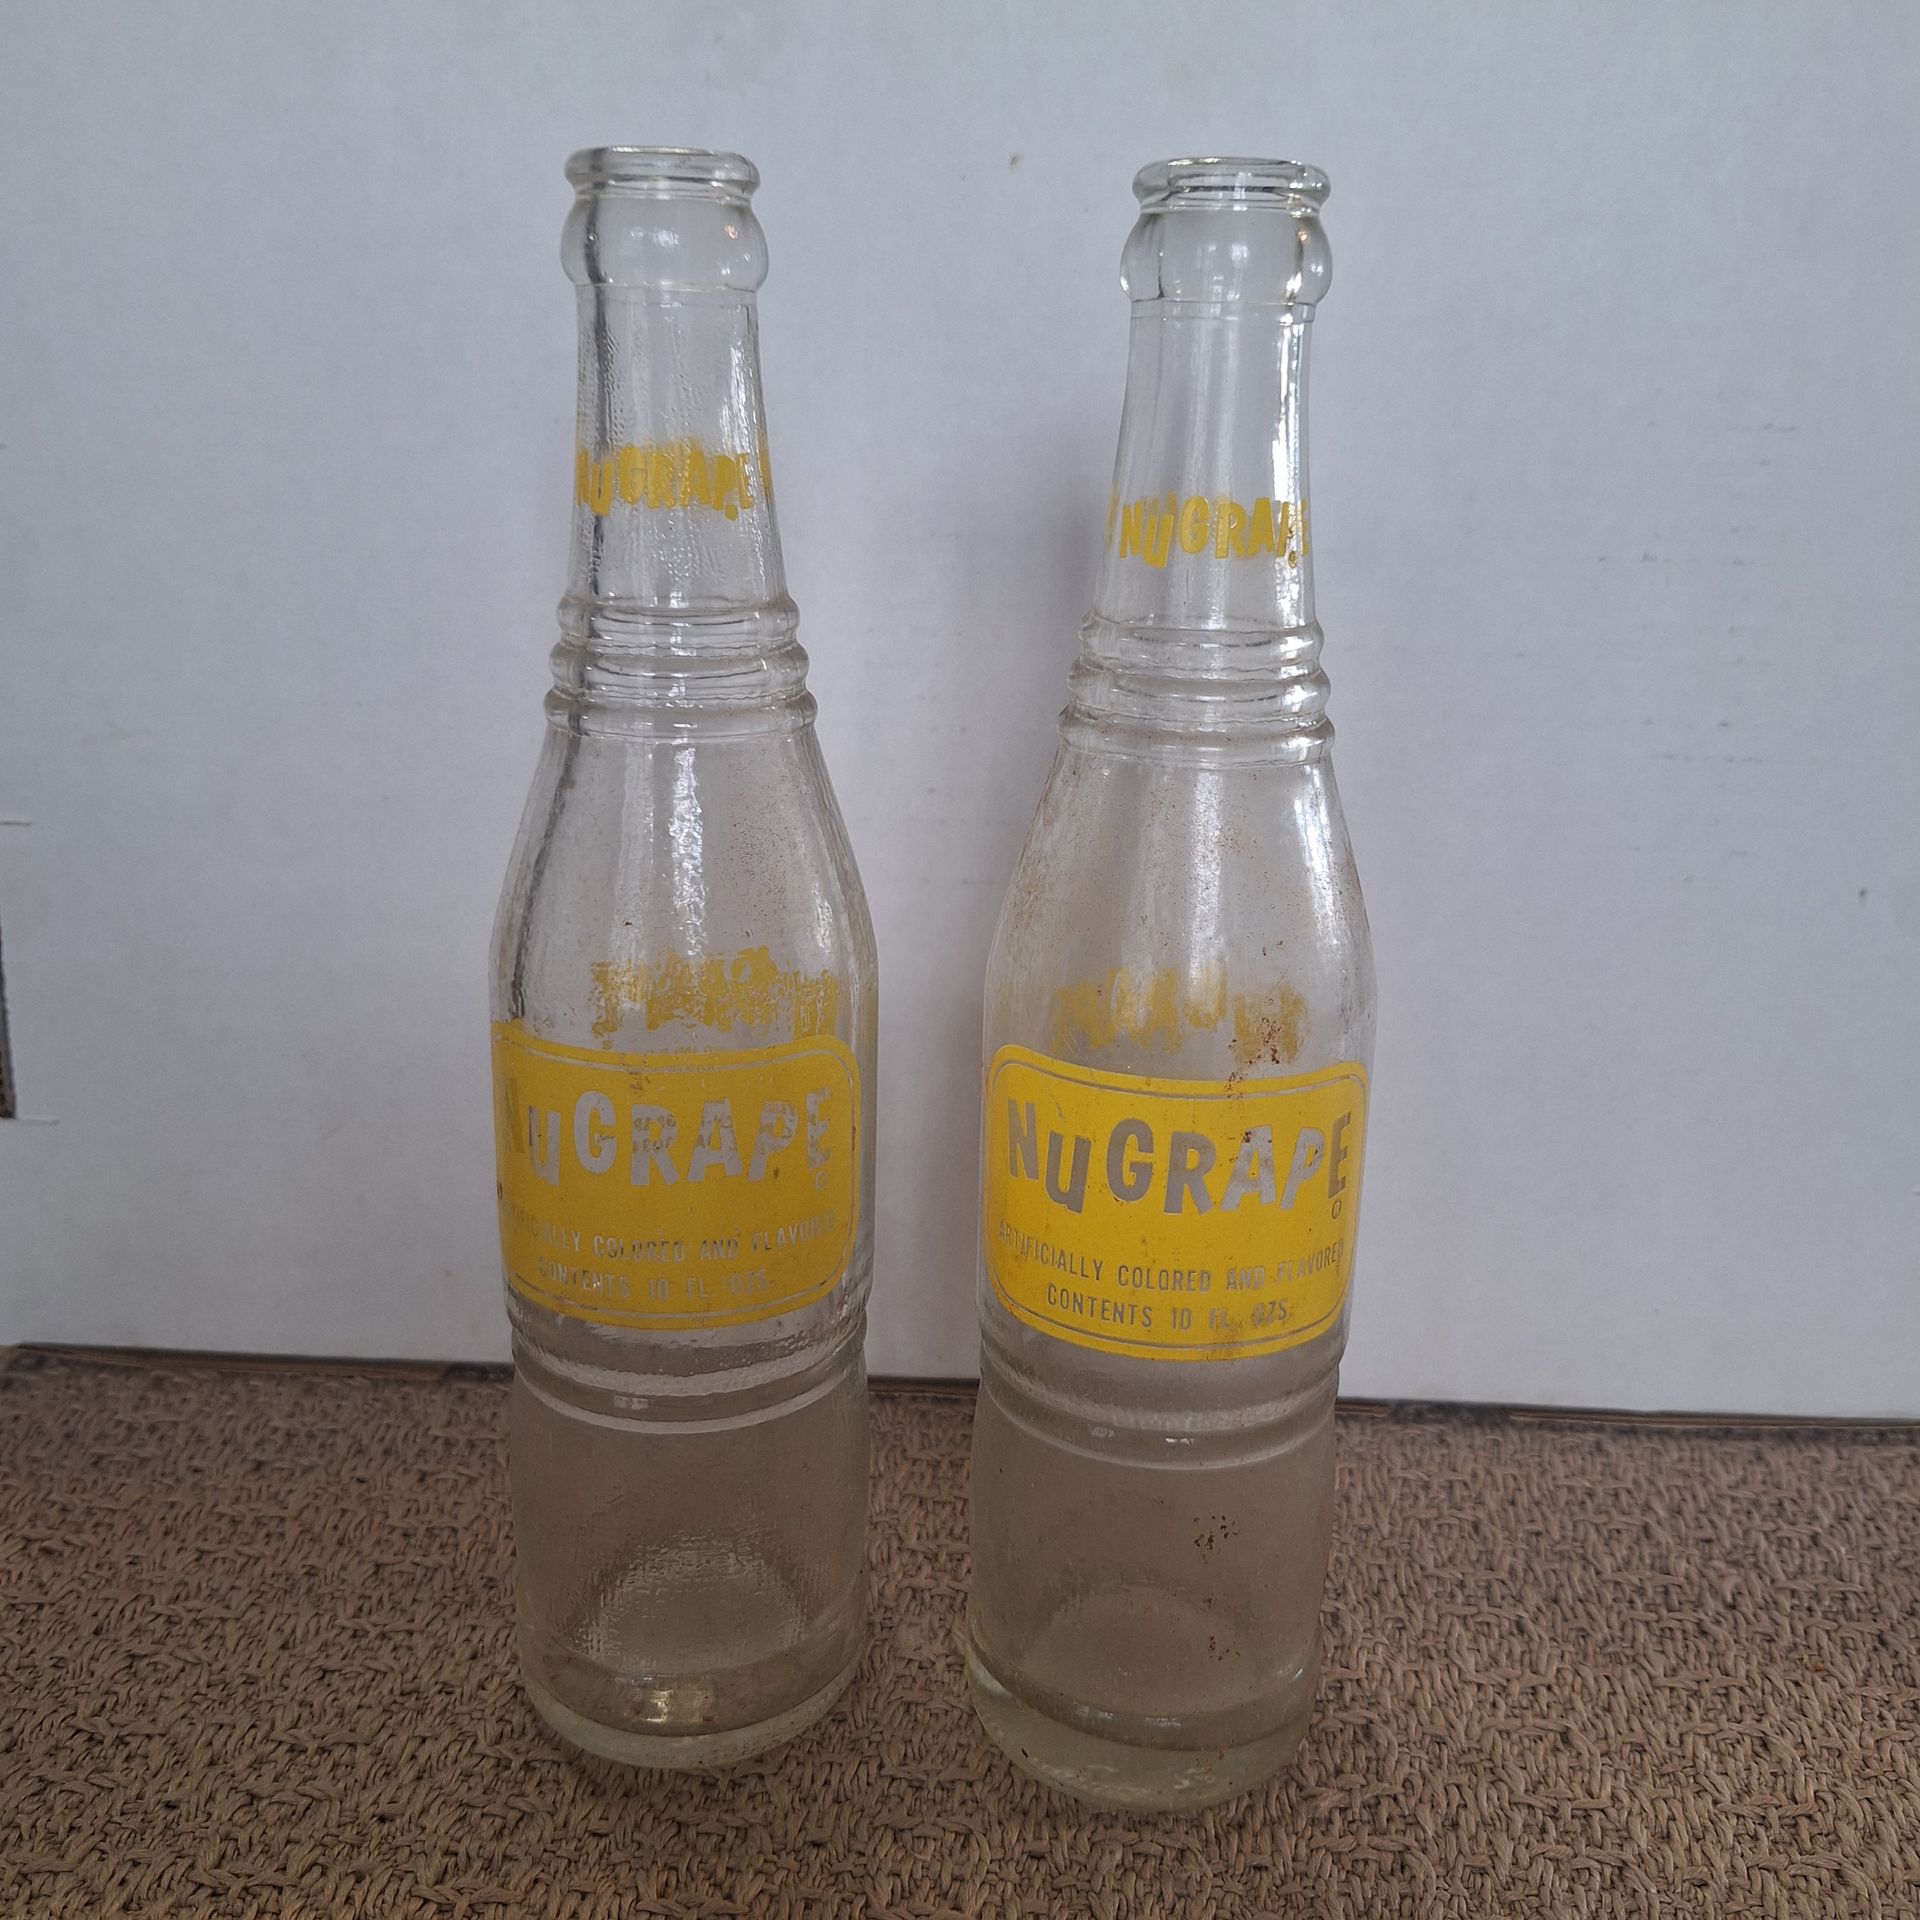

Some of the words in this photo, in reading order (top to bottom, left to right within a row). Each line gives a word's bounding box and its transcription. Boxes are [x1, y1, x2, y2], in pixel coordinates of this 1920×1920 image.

[700, 1237, 740, 1263] AND
[999, 1218, 1104, 1281] ARTIFICIALLY
[1117, 1264, 1211, 1292] COLORED
[1226, 1265, 1266, 1291] AND
[537, 1256, 631, 1299] CONTENTS
[648, 1278, 669, 1302] 10
[1047, 1284, 1153, 1328] CONTENTS
[1171, 1307, 1192, 1331] 10
